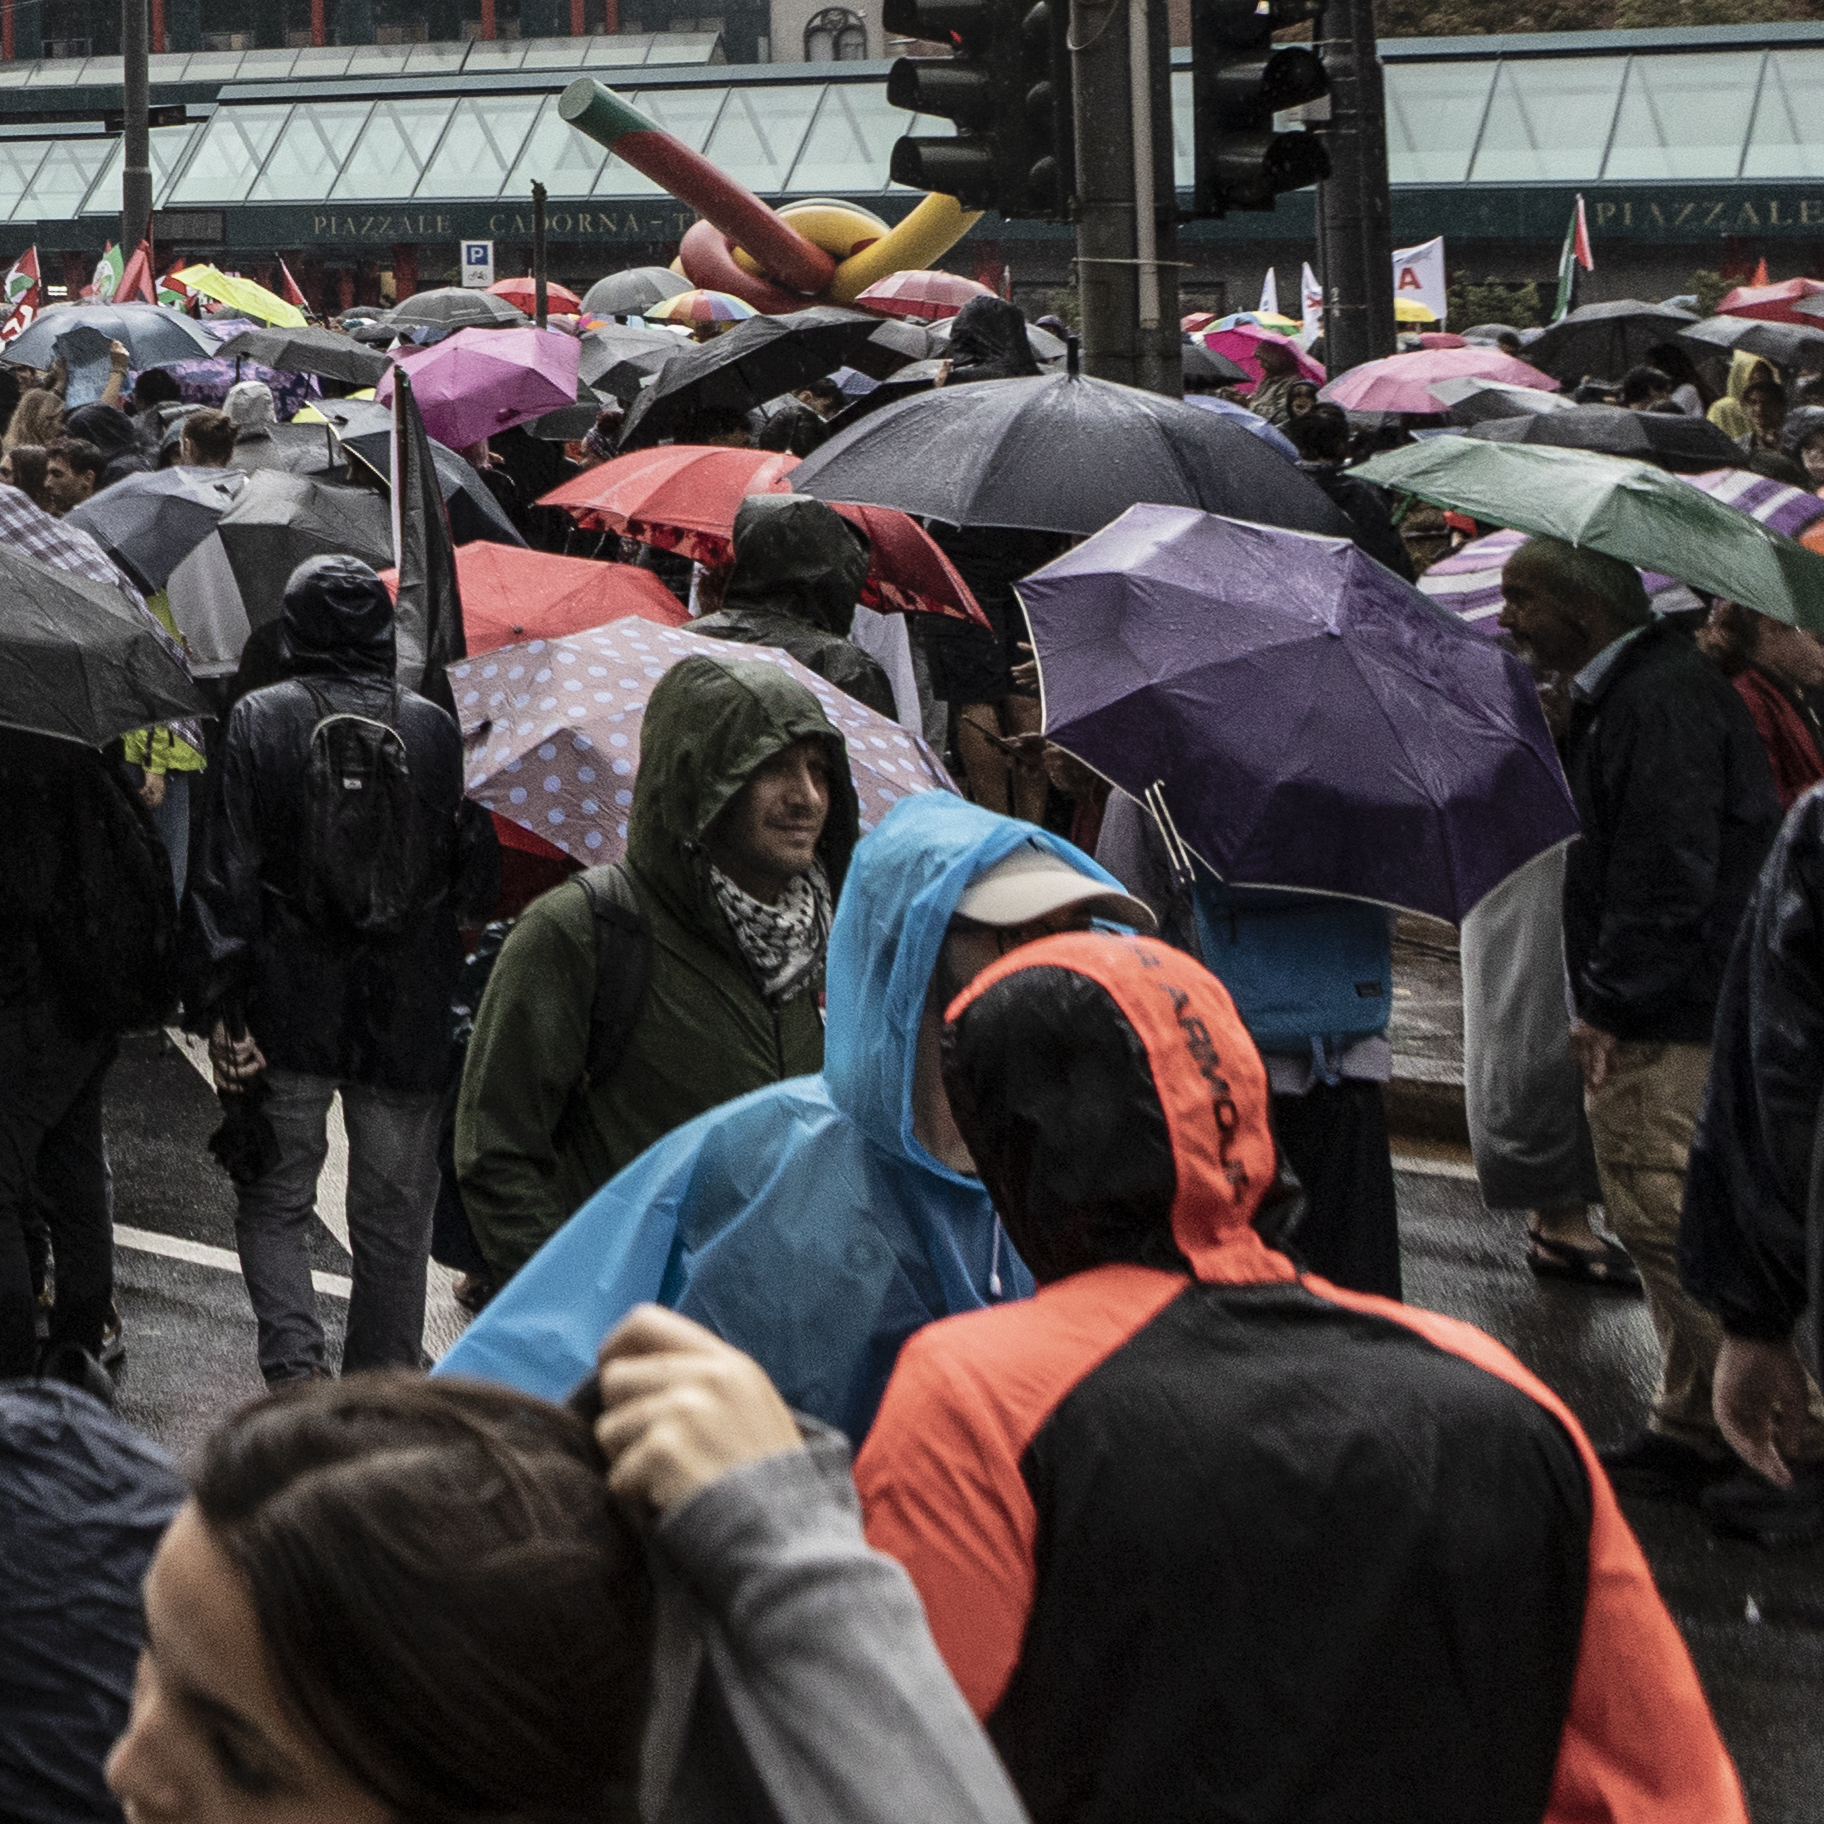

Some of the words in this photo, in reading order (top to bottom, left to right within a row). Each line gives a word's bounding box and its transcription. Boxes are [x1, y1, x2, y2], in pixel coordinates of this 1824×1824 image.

[314, 214, 452, 236] PIAZZALE
[489, 213, 640, 234] CADORNA
[471, 247, 483, 263] P
